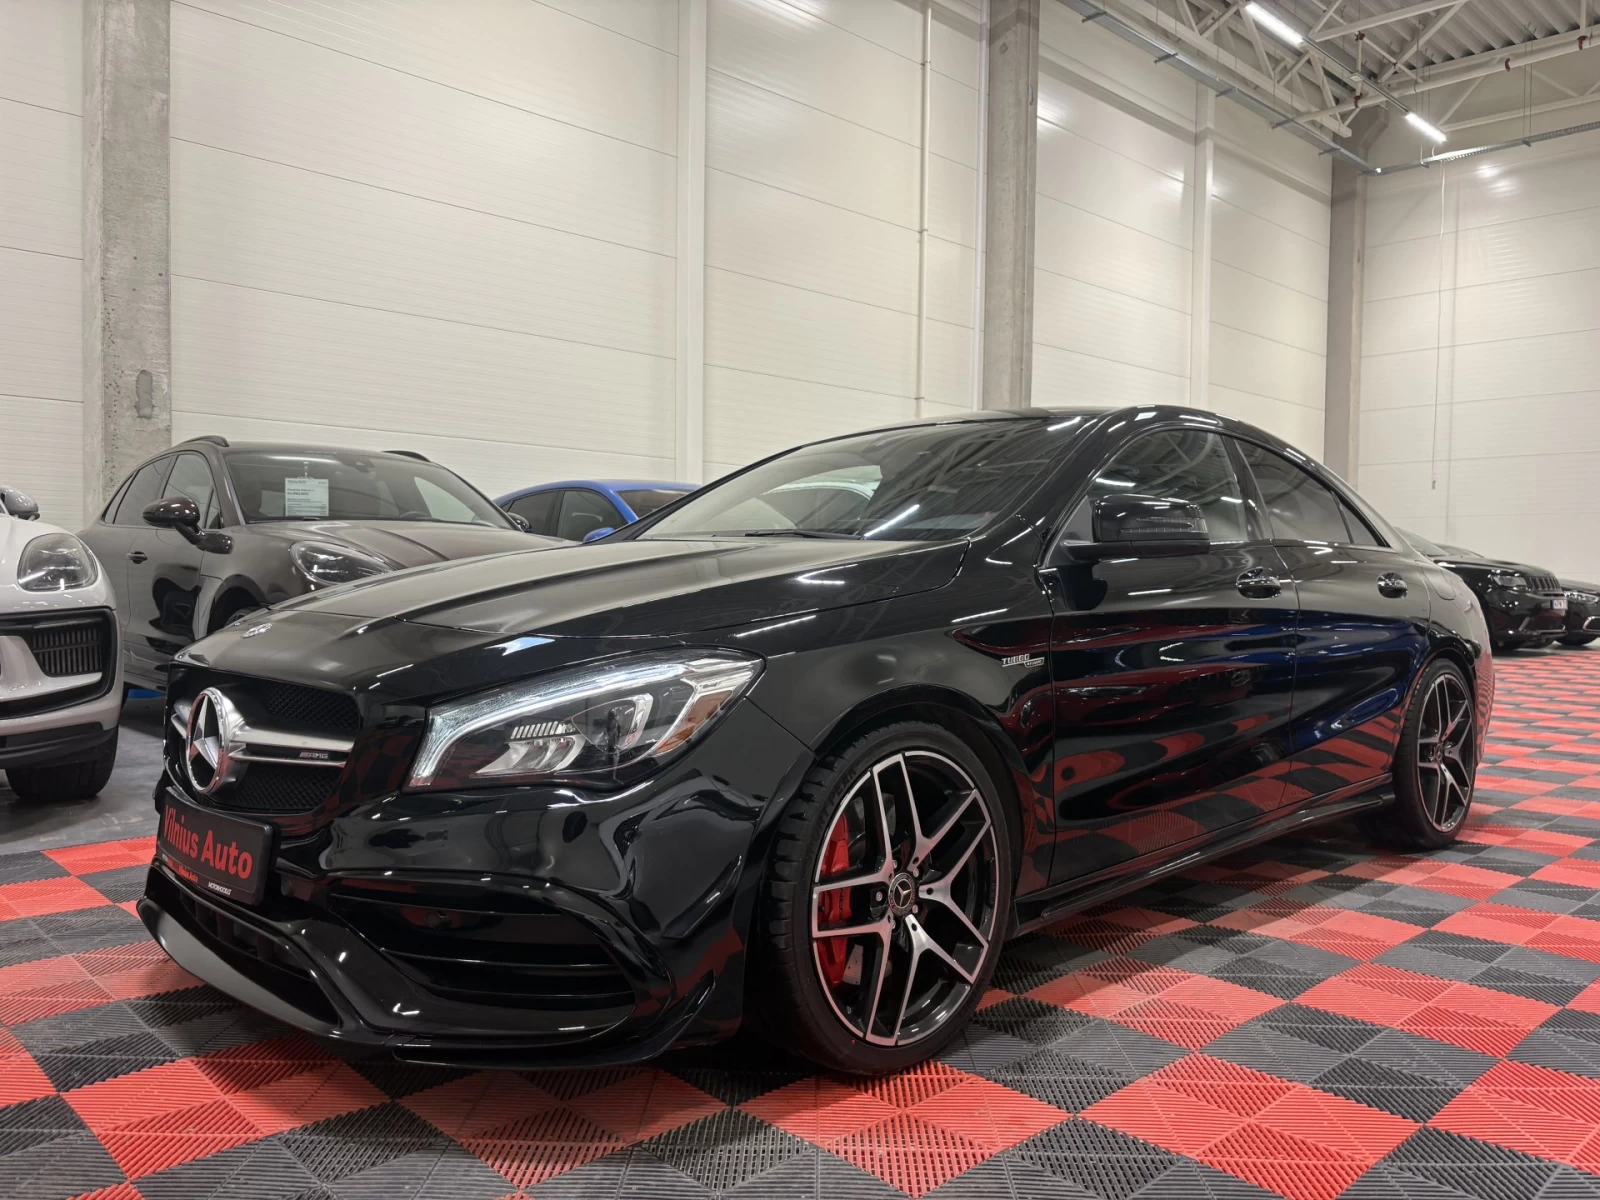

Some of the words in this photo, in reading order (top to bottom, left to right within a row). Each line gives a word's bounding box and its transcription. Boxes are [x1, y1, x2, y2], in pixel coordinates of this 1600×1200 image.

[1001, 653, 1030, 664] TURBO
[164, 805, 199, 858] Vilnius
[200, 829, 253, 879] Auto
